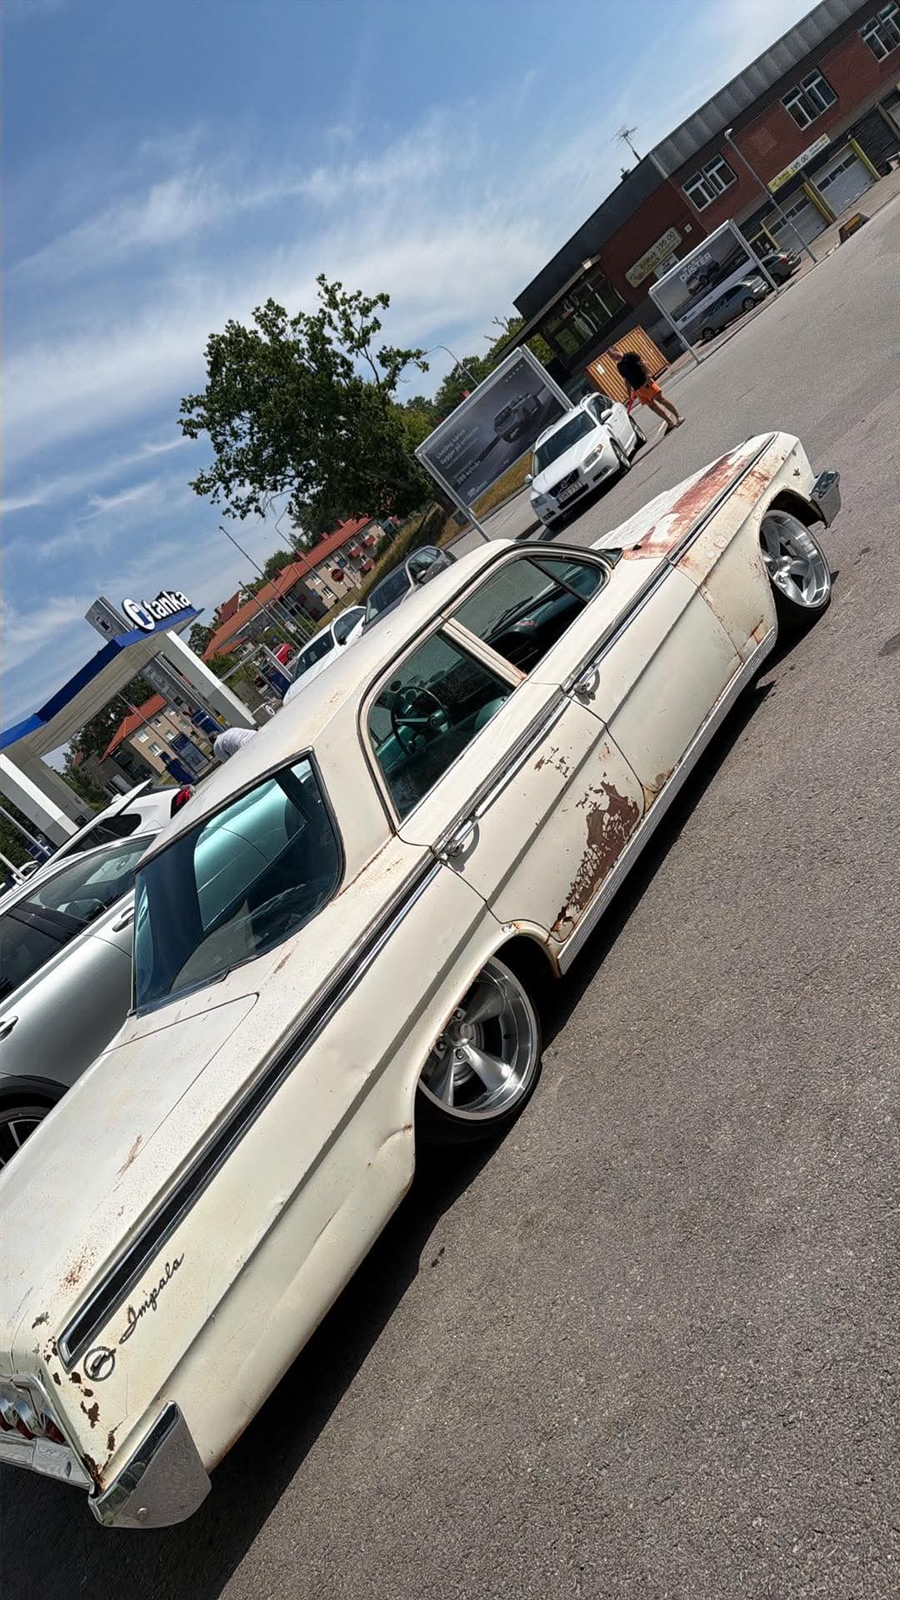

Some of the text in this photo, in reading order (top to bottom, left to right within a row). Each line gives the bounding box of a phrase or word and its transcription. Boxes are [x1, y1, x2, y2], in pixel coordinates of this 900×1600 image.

[679, 252, 713, 282] DUSTER
[141, 590, 192, 619] tanka
[118, 1253, 185, 1345] Impala
